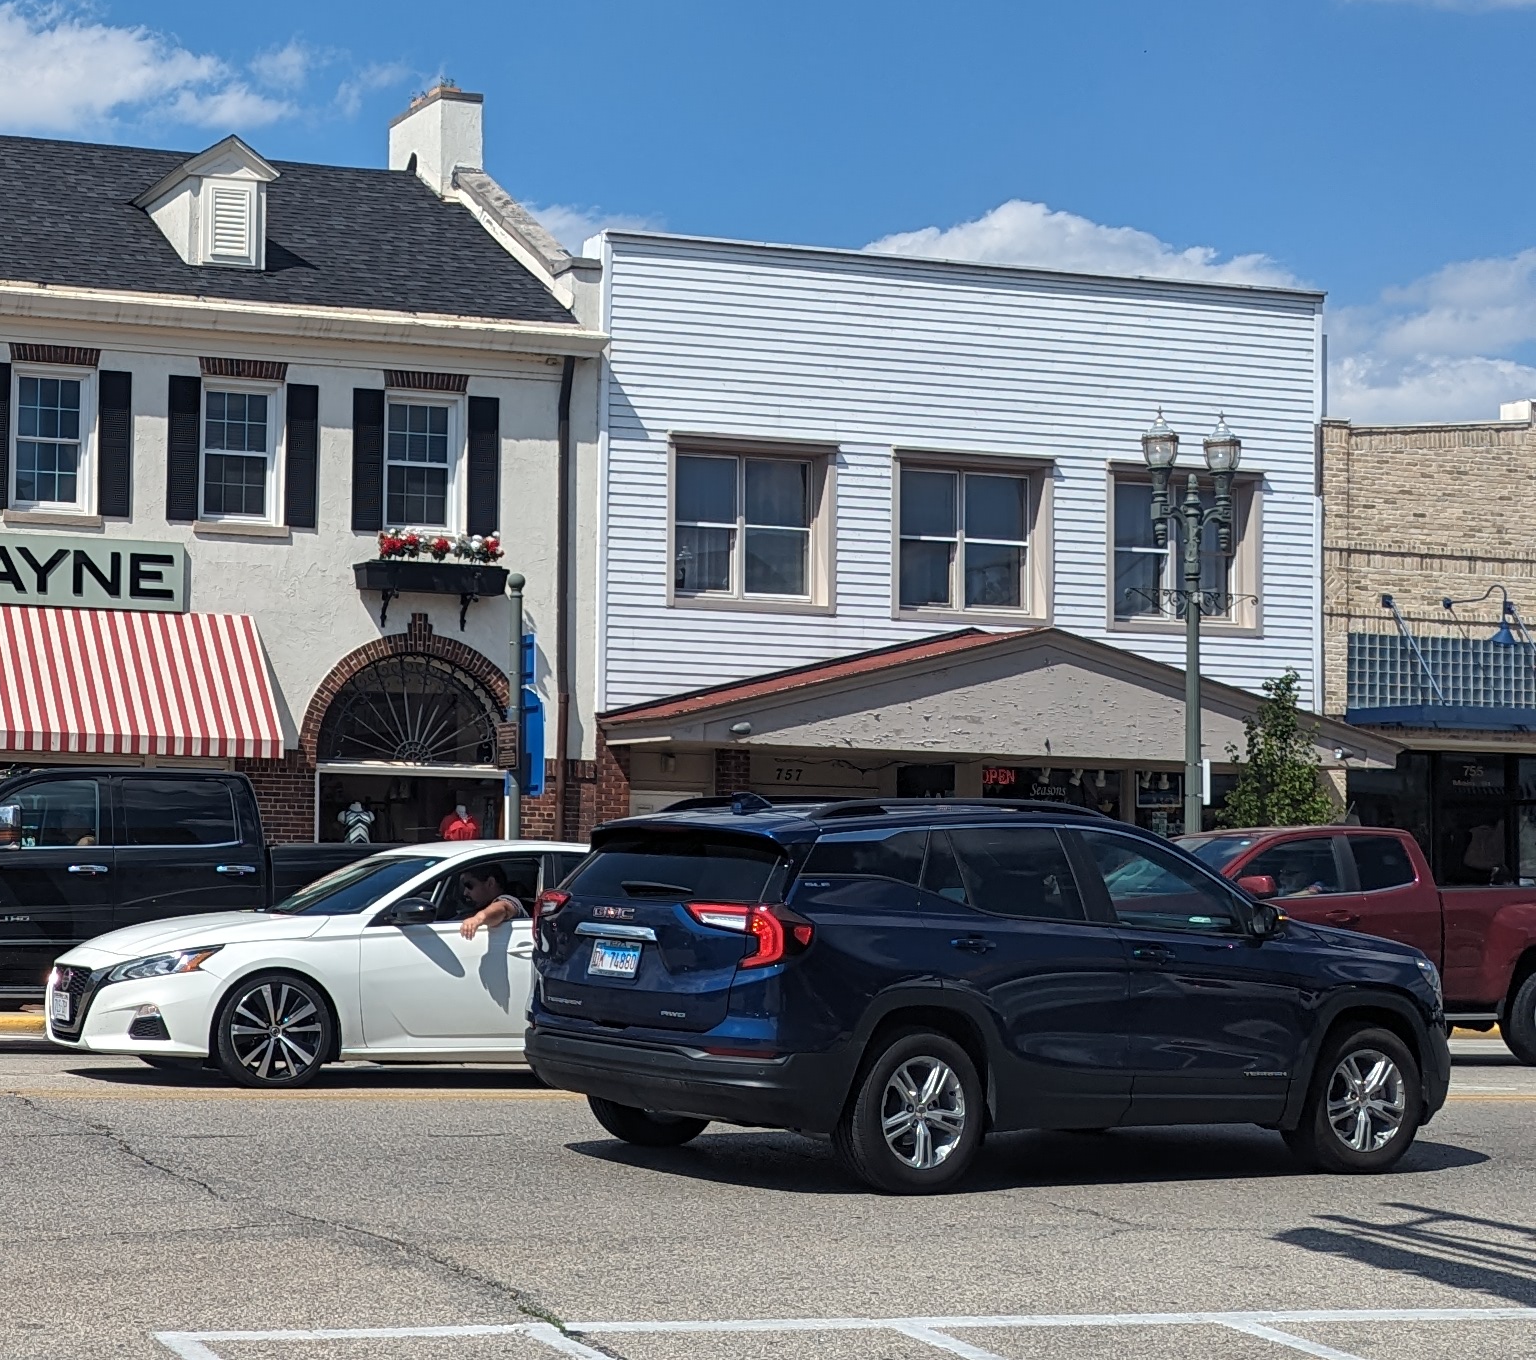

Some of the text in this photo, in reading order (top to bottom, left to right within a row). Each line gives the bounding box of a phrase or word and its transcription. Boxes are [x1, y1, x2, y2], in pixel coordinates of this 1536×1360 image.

[775, 768, 803, 781] 757
[1462, 766, 1484, 777] 755
[1030, 783, 1066, 797] Seasons
[592, 905, 635, 920] GMC
